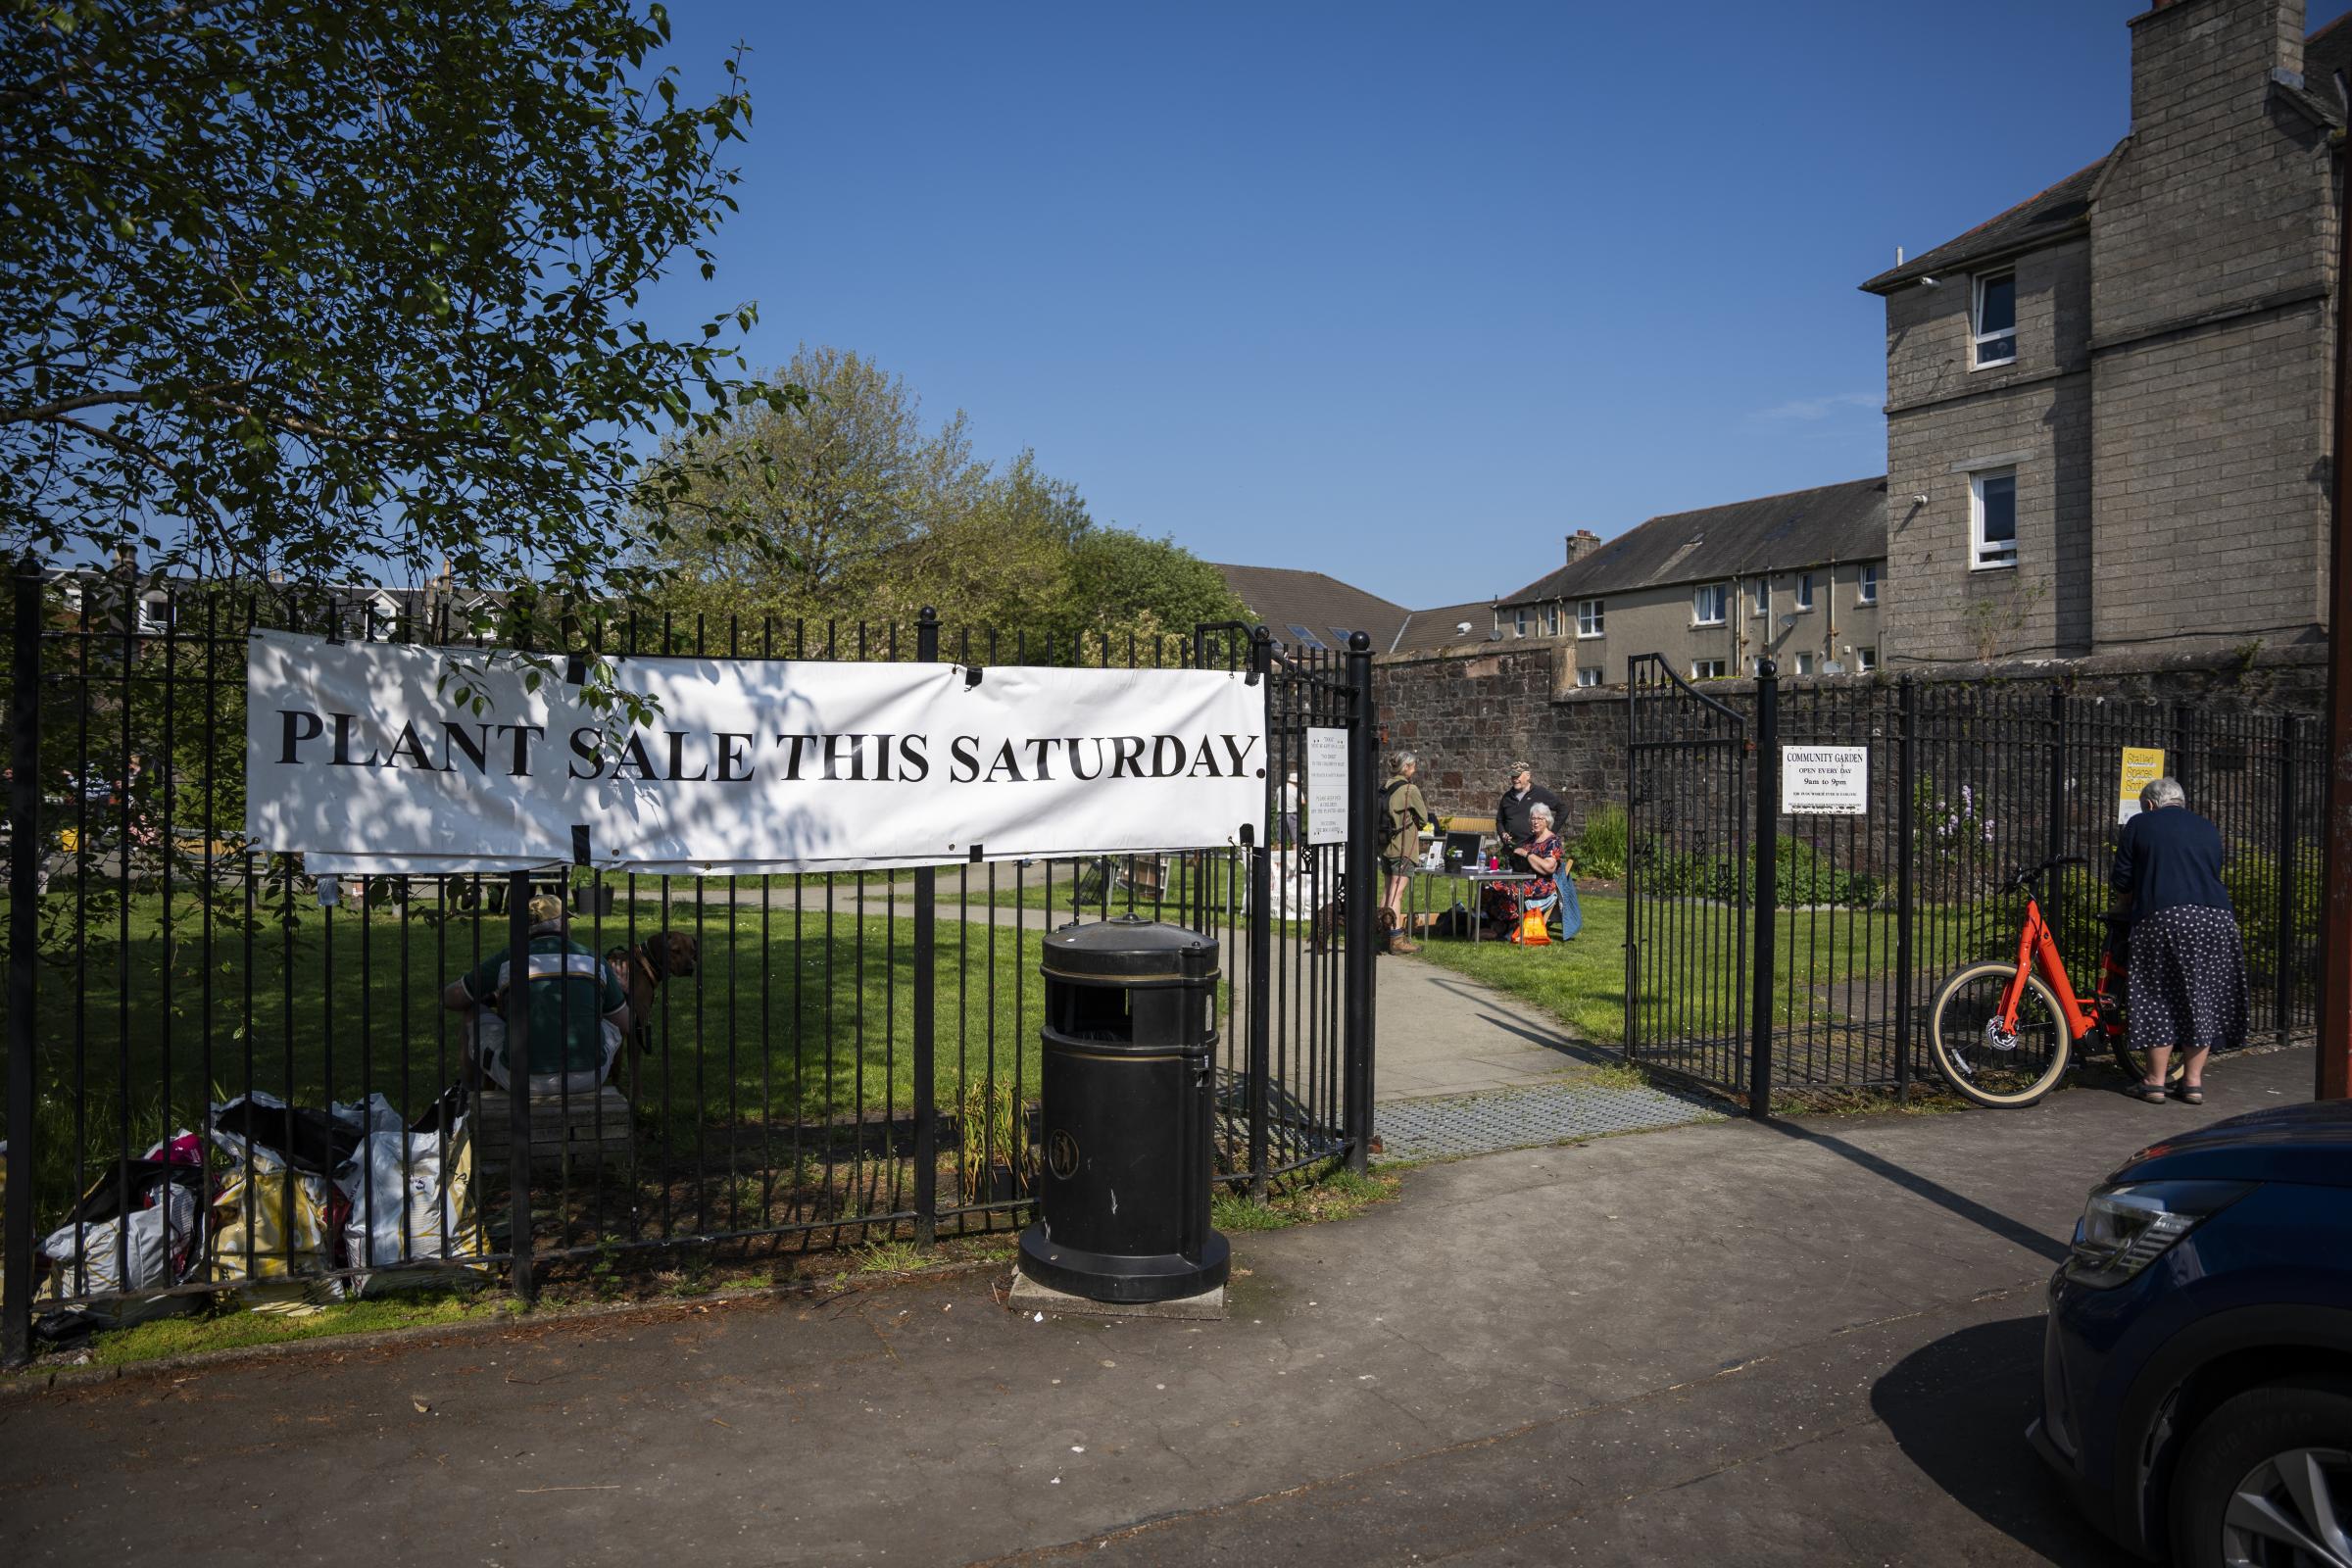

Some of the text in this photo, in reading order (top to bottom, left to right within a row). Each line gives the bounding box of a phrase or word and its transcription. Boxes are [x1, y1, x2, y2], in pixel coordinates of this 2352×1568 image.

[274, 710, 1267, 783] PLANT SALE THIS SATURDAY.
[1787, 753, 1863, 762] COMMUNITY GARDEN
